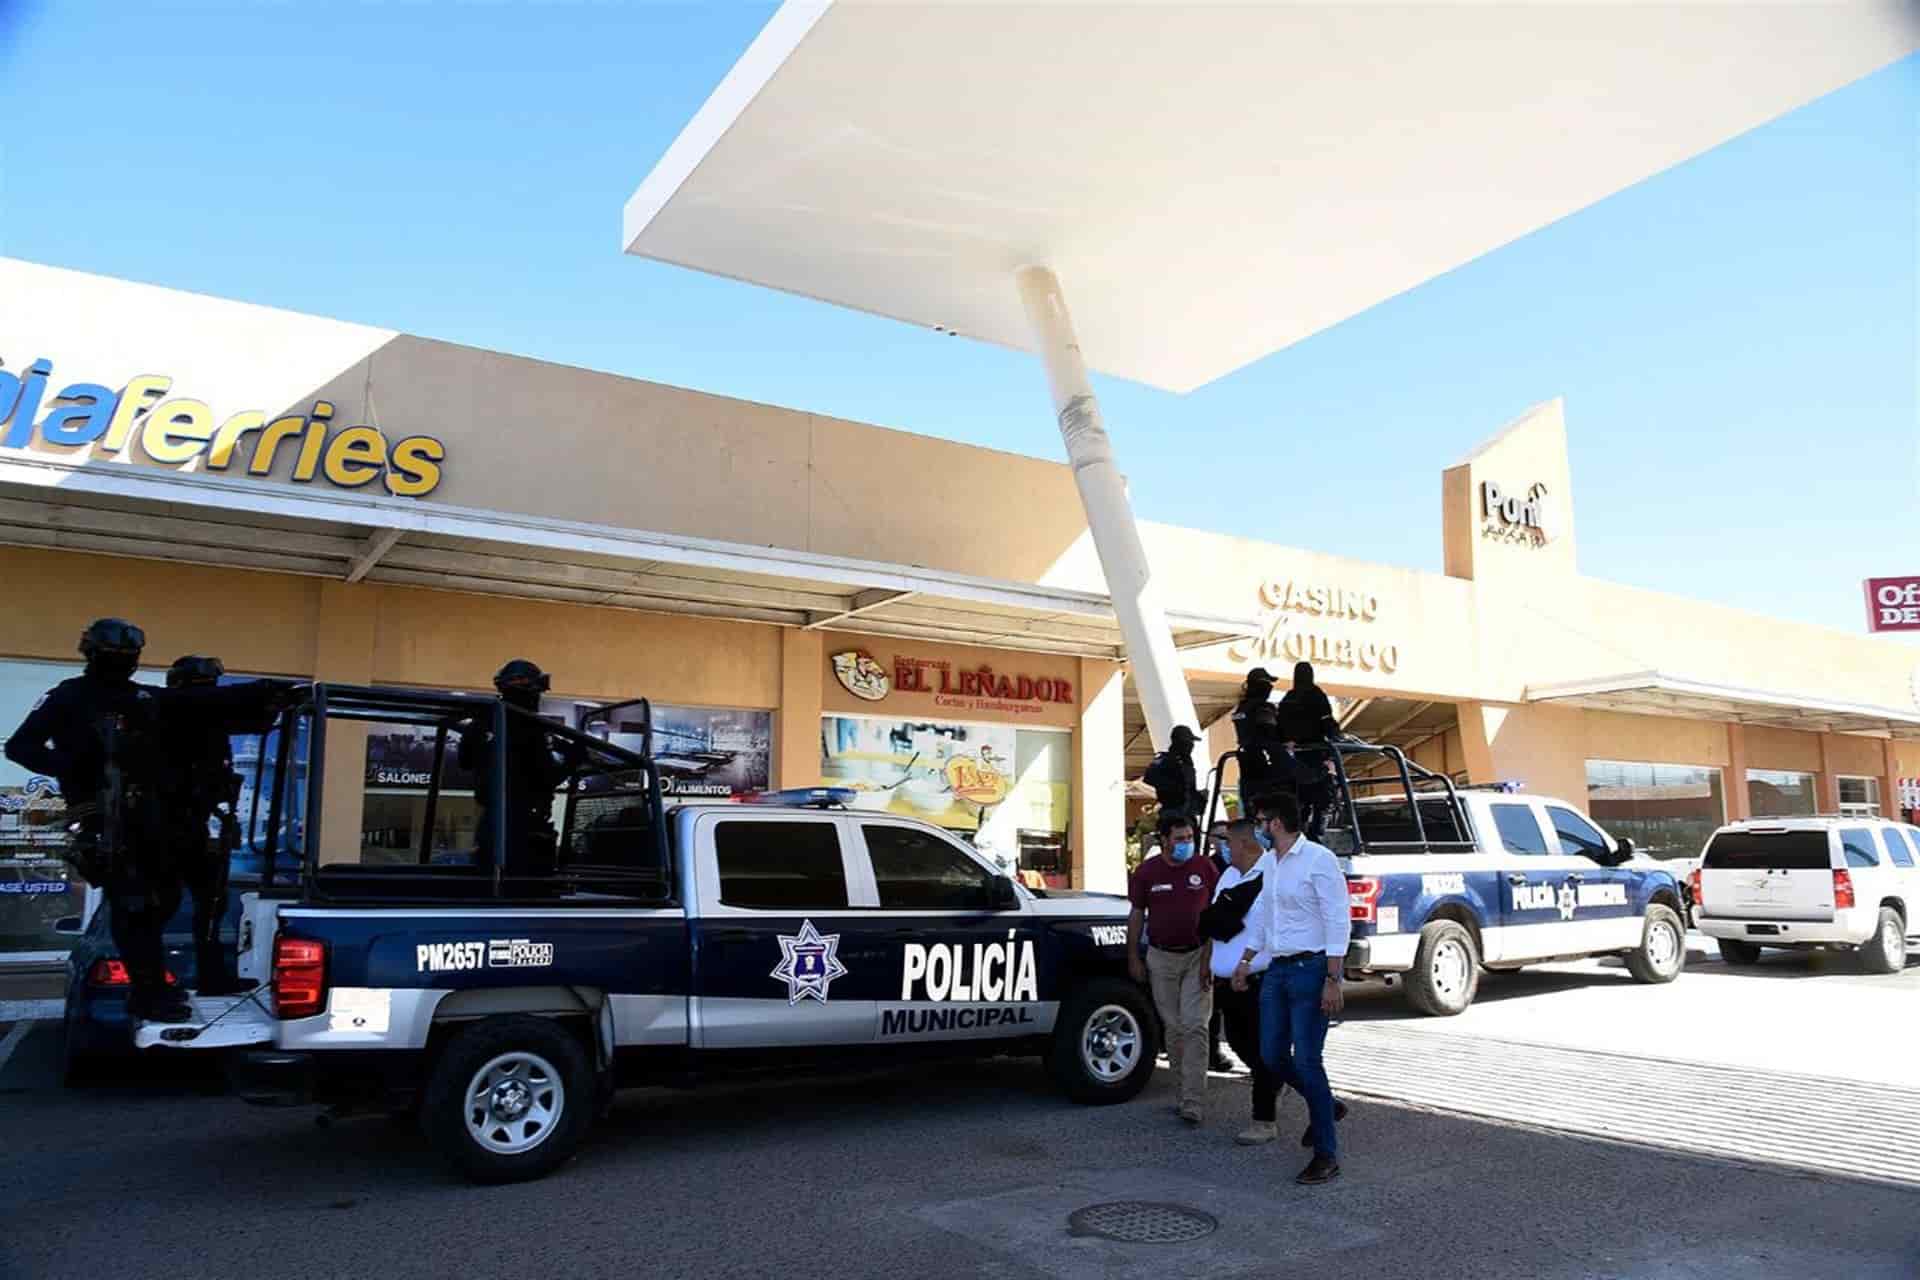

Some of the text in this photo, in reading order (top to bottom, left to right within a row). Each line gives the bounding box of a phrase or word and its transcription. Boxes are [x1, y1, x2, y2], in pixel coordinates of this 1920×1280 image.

[1258, 578, 1379, 622] CASINO
[894, 664, 1073, 704] EL LEÑADOR
[416, 941, 486, 972] PM2657
[901, 928, 1038, 1001] POLICÍA
[881, 1006, 1033, 1036] MUNICIPAL
